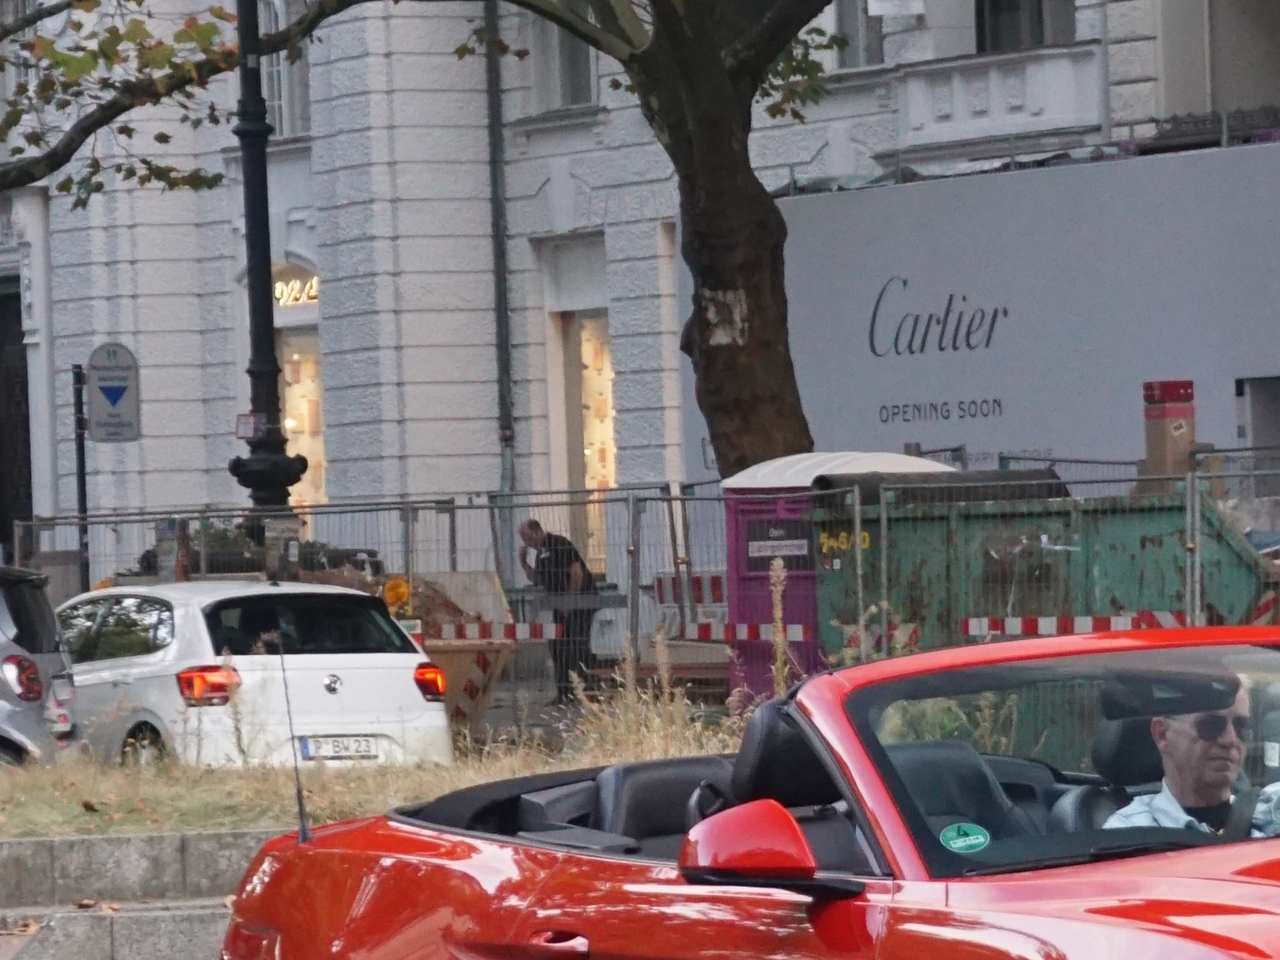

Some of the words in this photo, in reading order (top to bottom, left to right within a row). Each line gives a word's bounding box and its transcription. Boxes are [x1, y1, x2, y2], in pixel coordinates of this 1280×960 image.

[869, 276, 1009, 357] Cartier
[879, 402, 951, 424] OPENING
[957, 398, 1003, 419] SOON
[353, 739, 371, 754] 23
